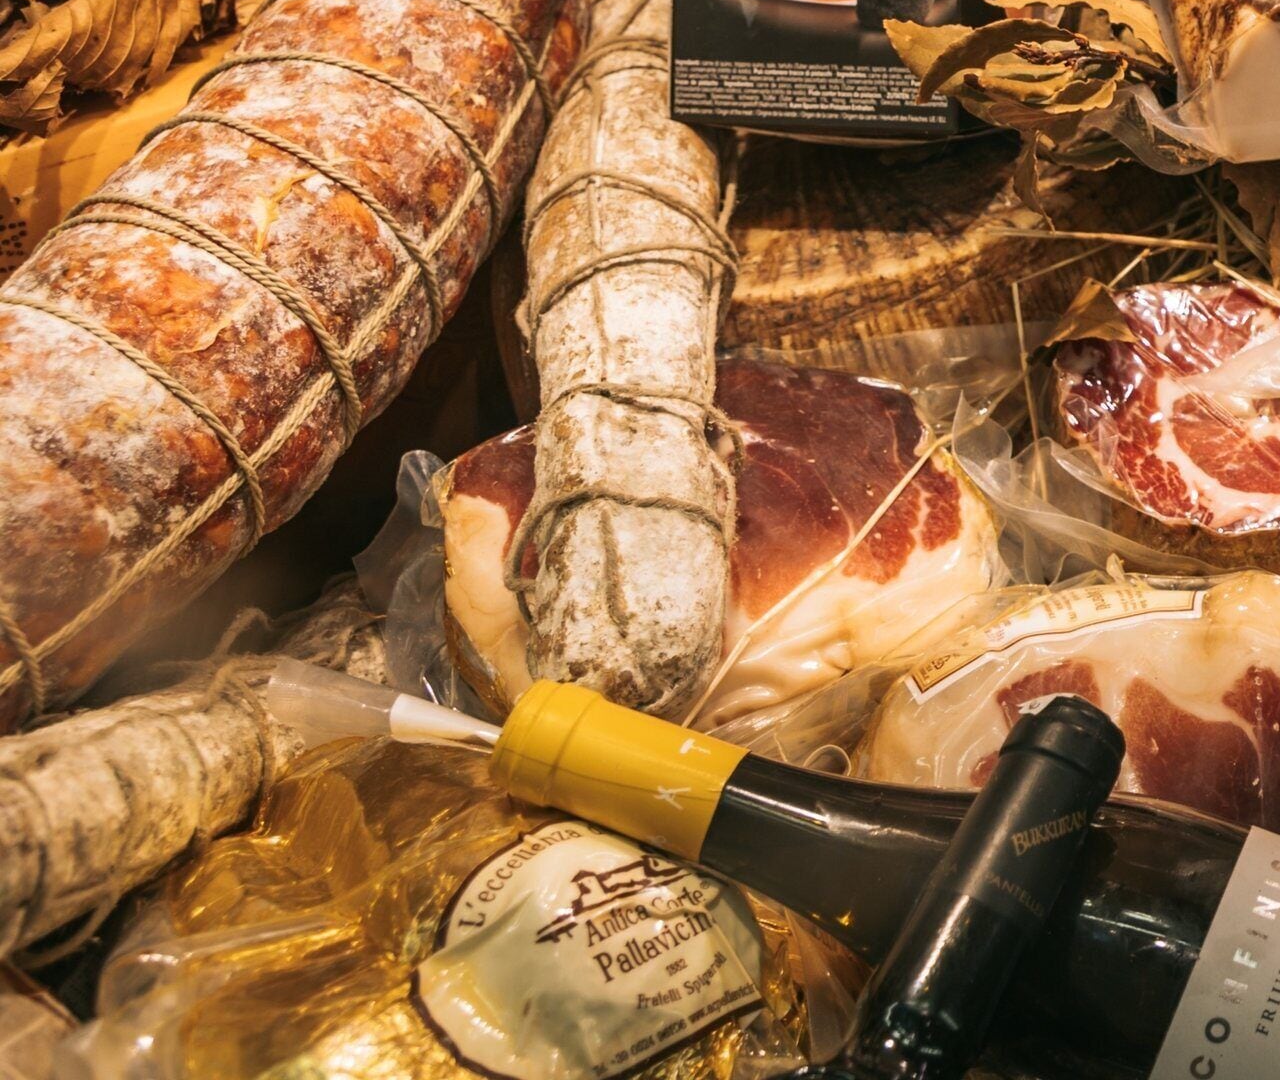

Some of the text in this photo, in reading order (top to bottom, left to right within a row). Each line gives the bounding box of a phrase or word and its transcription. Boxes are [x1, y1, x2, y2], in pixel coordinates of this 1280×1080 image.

[458, 828, 583, 928] L'eccellenza
[584, 904, 651, 948] Antica
[592, 910, 717, 985] Pallavicin
[636, 987, 683, 1011] Fratelli
